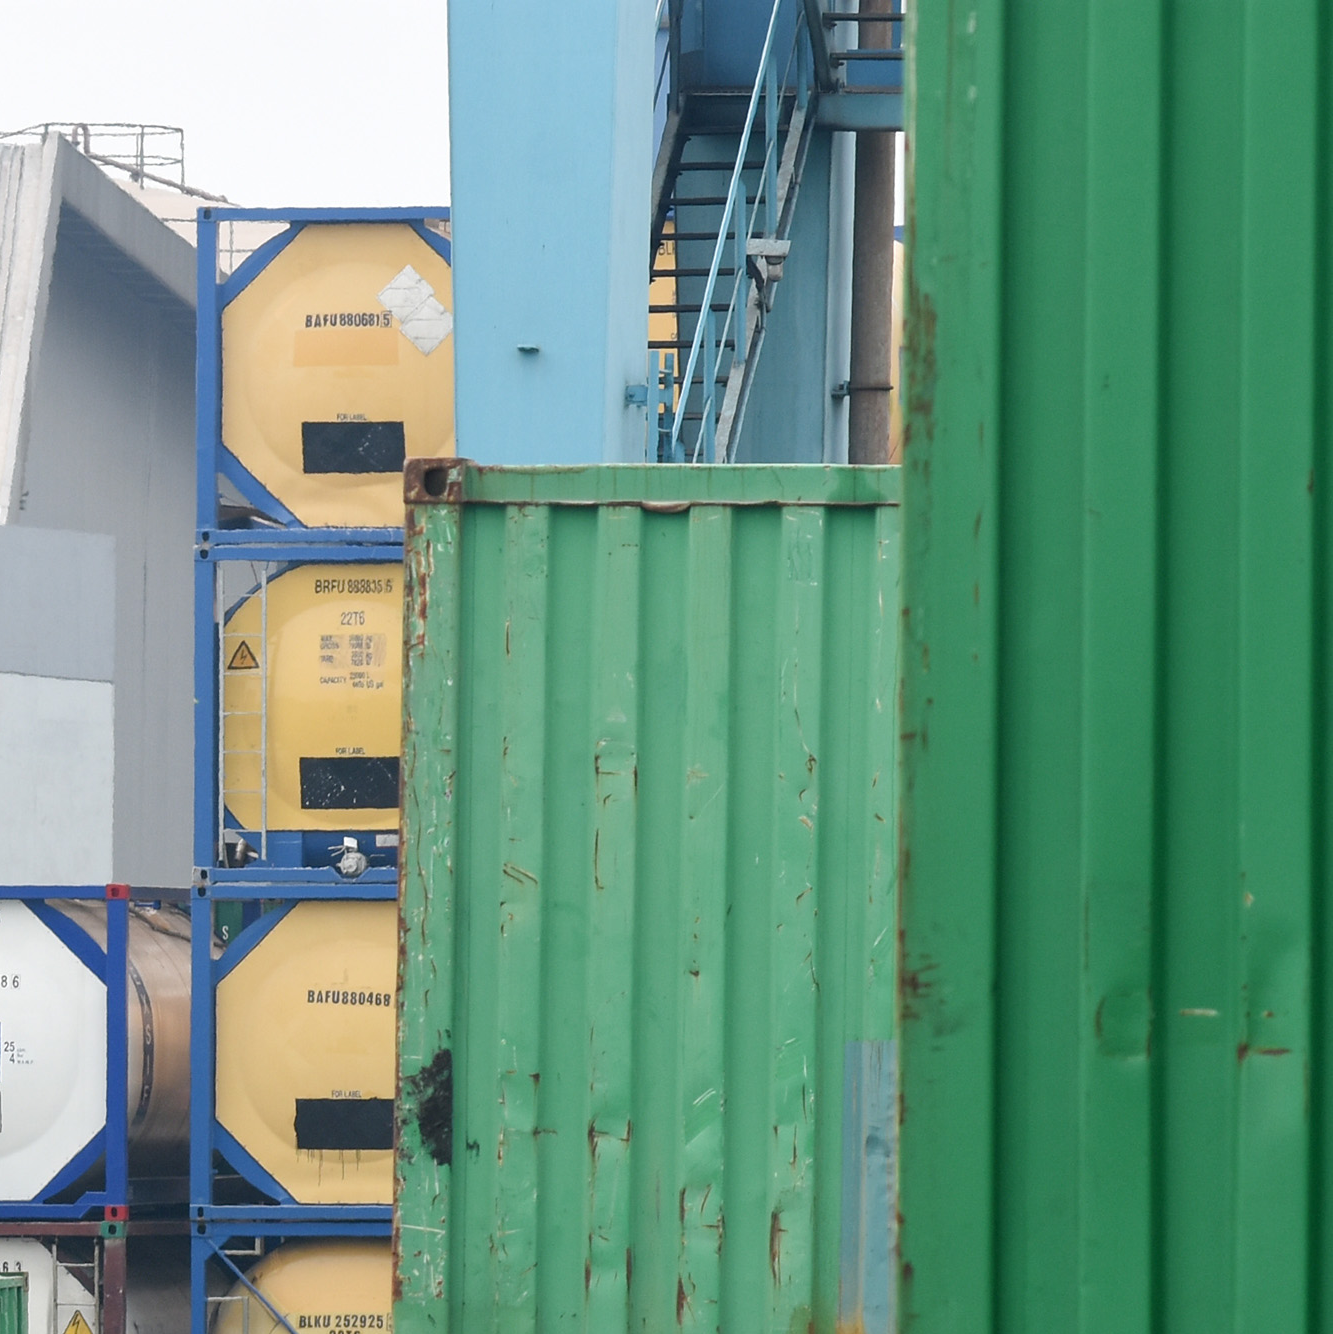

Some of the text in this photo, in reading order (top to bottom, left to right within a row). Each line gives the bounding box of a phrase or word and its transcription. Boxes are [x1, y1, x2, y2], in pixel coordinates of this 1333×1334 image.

[341, 611, 365, 626] 22T6
[12, 975, 20, 988] 6
[4, 1042, 15, 1052] 25
[9, 1055, 15, 1064] 4
[299, 1314, 384, 1329] BLKU 252925
